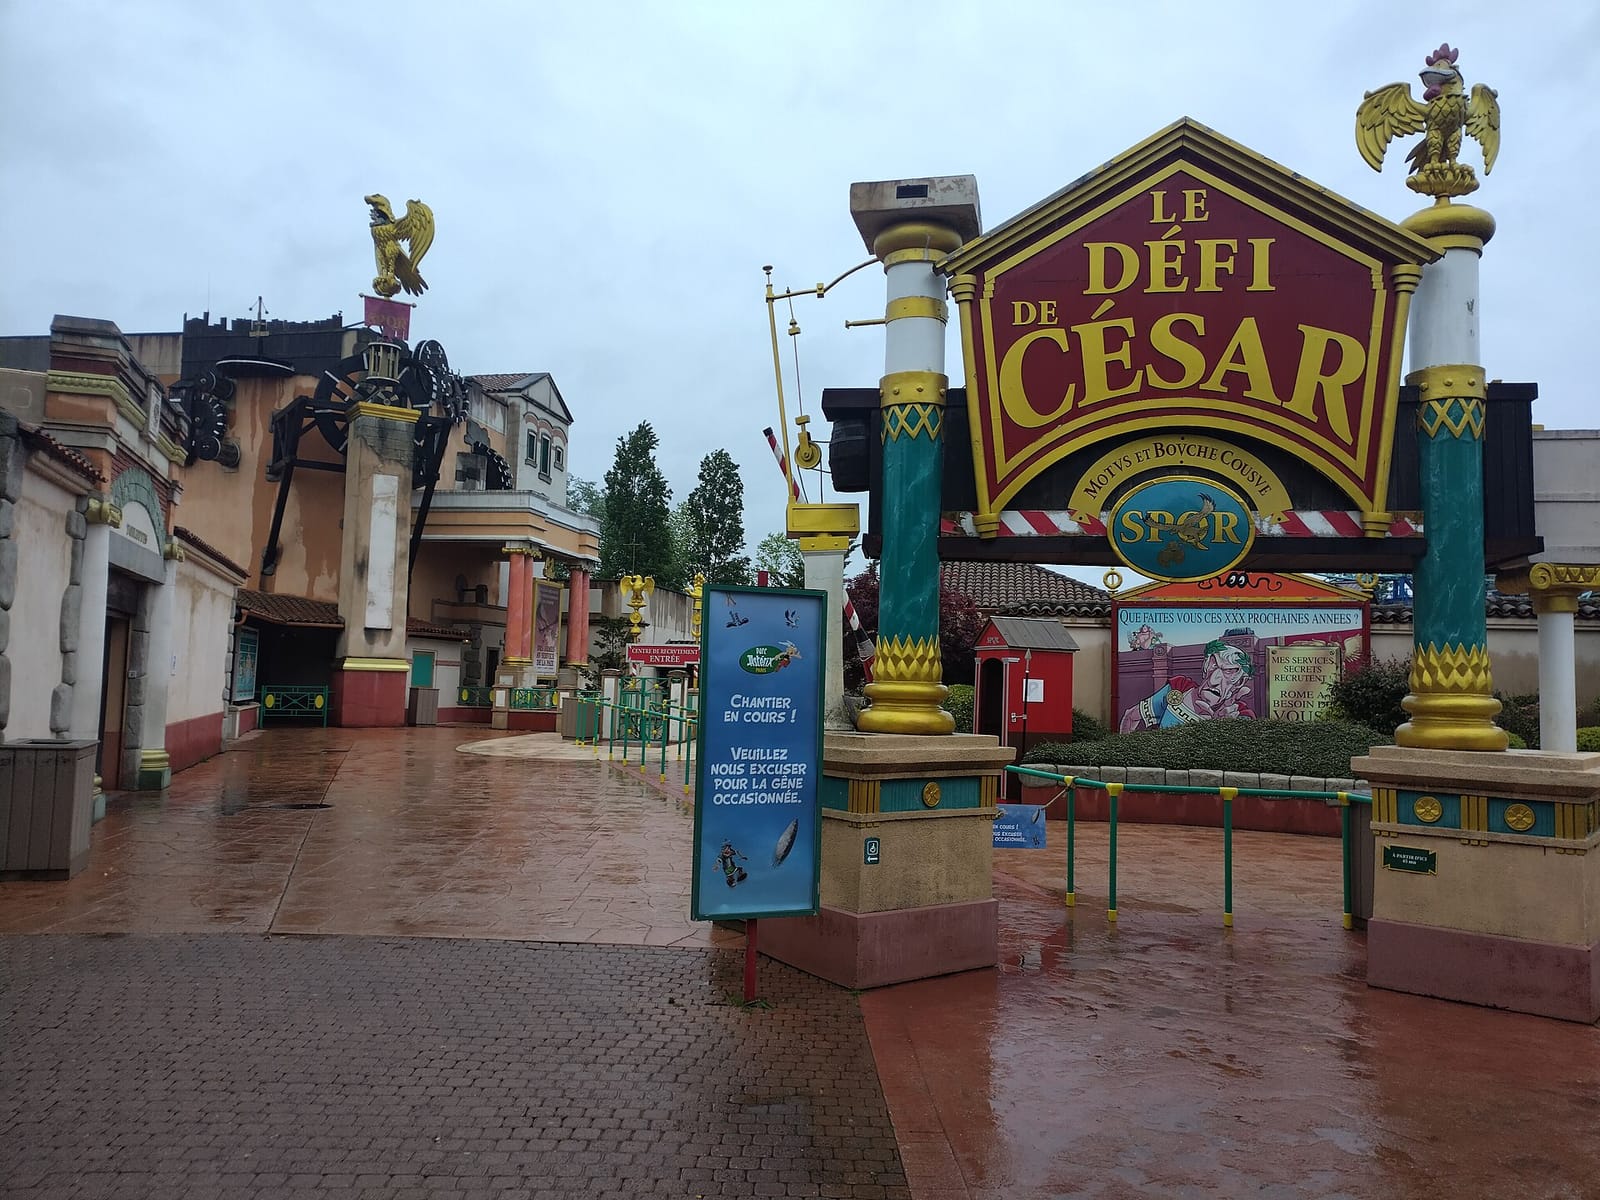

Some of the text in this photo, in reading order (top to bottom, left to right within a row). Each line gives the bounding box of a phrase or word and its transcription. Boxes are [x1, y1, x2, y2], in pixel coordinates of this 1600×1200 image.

[1149, 188, 1210, 224] LE
[1083, 225, 1276, 295] DÉFI
[1012, 300, 1058, 326] DE
[1000, 298, 1366, 446] CÉSAR
[1083, 454, 1133, 500] MOTVS
[1136, 448, 1151, 464] ET
[1152, 442, 1217, 461] BOVCHE
[1120, 510, 1242, 550] SPQR
[1120, 609, 1359, 626] QUE FAITES VOUS CES XXX PROCHAINES ANNEES ?
[649, 655, 681, 663] ENTRÉE
[1272, 656, 1335, 665] MES SERVICES
[1284, 665, 1323, 674] SECRETS
[1274, 674, 1327, 682] RECRUTENT
[730, 694, 791, 709] CHANTIER
[1280, 690, 1314, 699] ROME
[1273, 700, 1314, 708] BESOIN
[724, 709, 797, 723] EN COURS !
[1273, 710, 1324, 723] VOUS
[710, 763, 807, 776] NOUS EXCUSER
[714, 774, 804, 790] POUR LA GÊNE
[712, 789, 802, 805] OCCASIONNÉE.
